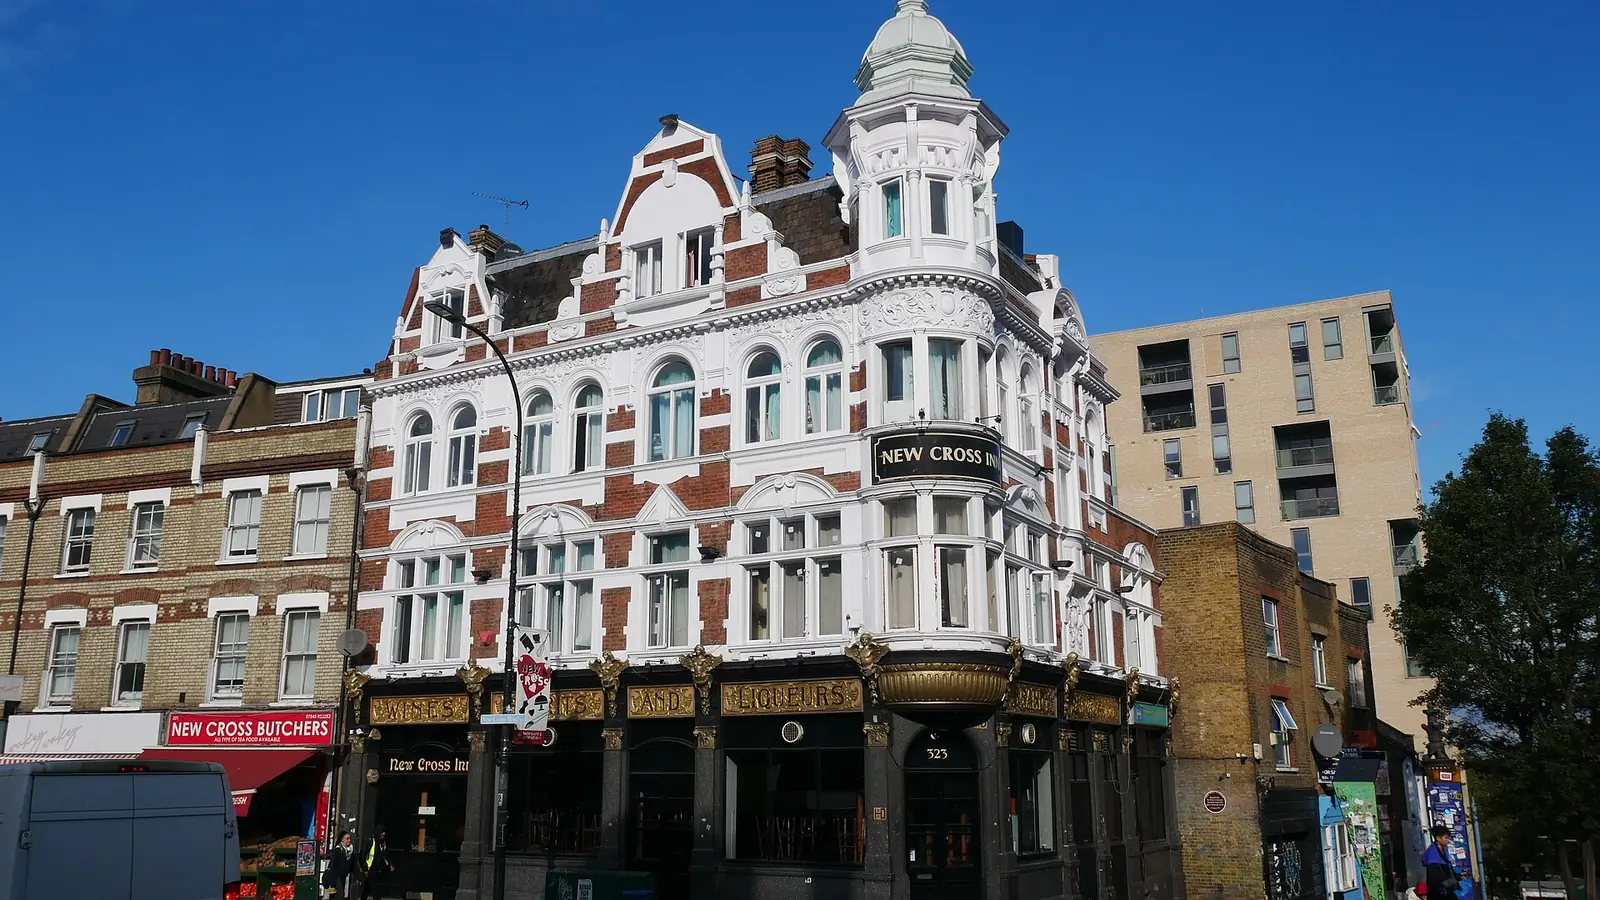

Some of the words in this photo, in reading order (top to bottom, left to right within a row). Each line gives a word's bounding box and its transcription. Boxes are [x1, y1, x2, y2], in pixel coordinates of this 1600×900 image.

[882, 446, 923, 465] NEW
[930, 446, 982, 464] CROSS
[522, 664, 542, 673] NEW
[519, 673, 549, 686] CROSS
[641, 691, 680, 712] AND
[738, 685, 845, 709] LIQUEURS
[386, 700, 454, 719] WINES
[171, 721, 203, 737] NEW
[206, 720, 253, 737] CROSS
[257, 720, 329, 736] BUTCHERS
[926, 748, 948, 760] 323
[389, 758, 415, 771] New
[417, 757, 451, 771] Cross
